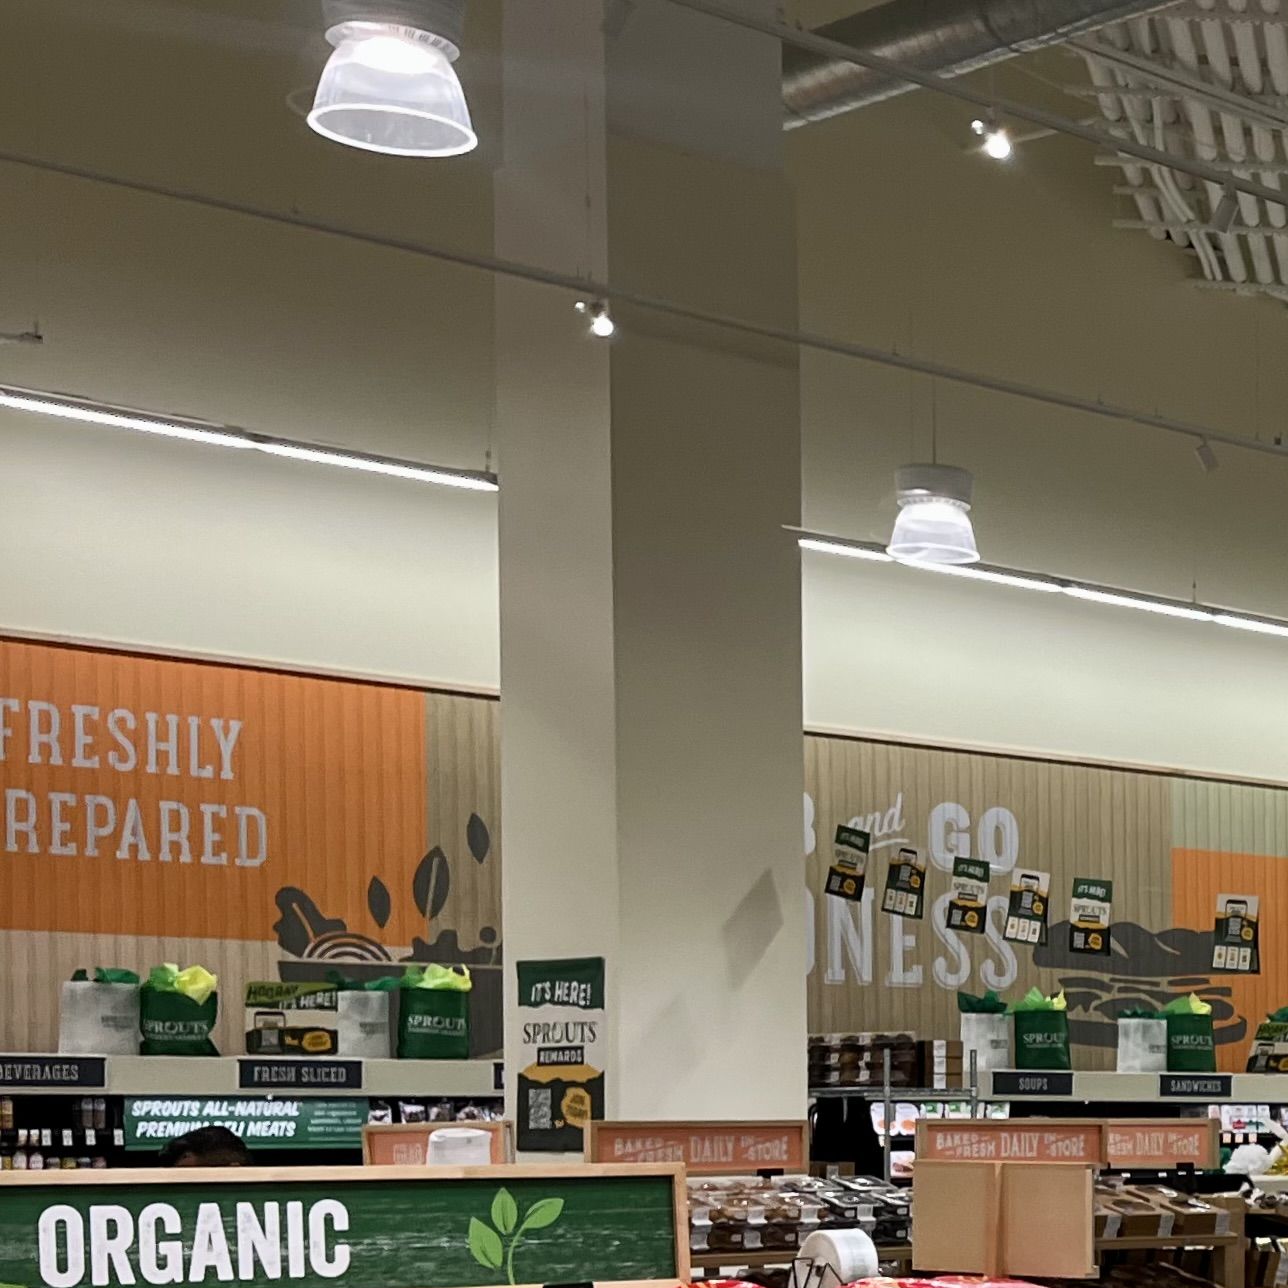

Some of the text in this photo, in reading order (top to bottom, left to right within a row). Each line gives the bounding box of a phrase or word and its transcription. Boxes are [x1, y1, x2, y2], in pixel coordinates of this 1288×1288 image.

[0, 697, 242, 780] FRESHLY
[5, 788, 268, 868] REPARED
[847, 791, 907, 840] and
[928, 801, 1019, 876] GO
[824, 887, 1019, 990] NESS
[522, 1021, 598, 1044] SPROUTS
[253, 1066, 347, 1083] FRESH SLICED
[1018, 1077, 1048, 1091] SOUPS
[132, 1100, 300, 1117] SPROUTS ALL-NATURAL
[136, 1121, 211, 1138] PREMIU
[247, 1121, 297, 1138] MEATS
[690, 1136, 735, 1163] DAILY
[1000, 1131, 1039, 1158] DAILY
[1135, 1132, 1165, 1156] DAILY
[37, 1198, 351, 1288] ORGANIC
